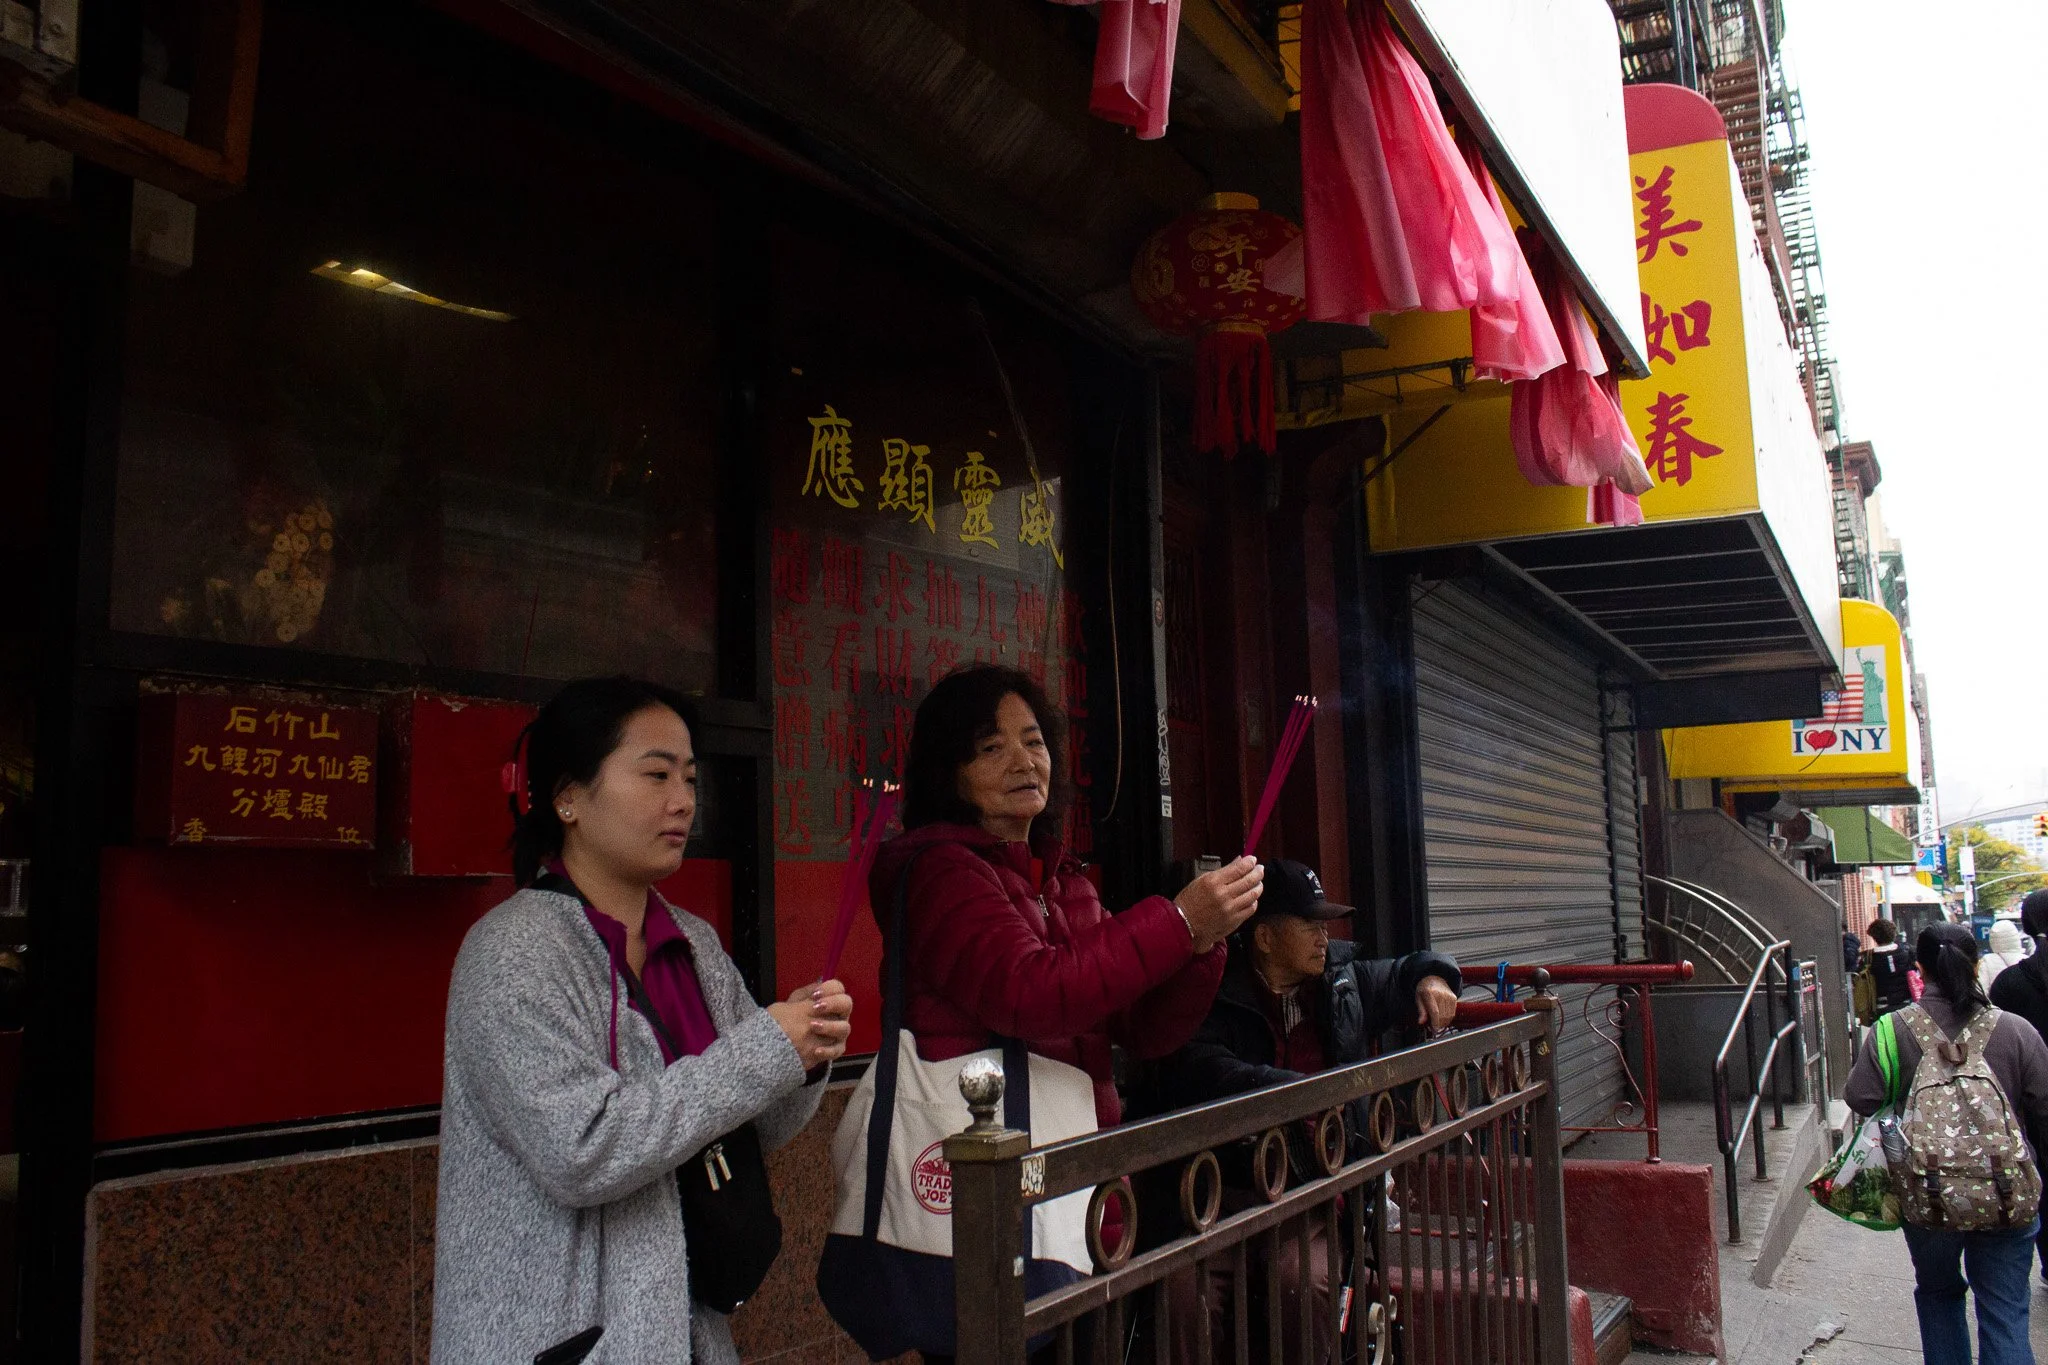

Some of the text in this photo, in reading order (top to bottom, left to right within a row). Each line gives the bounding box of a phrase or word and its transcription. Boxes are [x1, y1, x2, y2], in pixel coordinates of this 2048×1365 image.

[224, 706, 340, 740] 石竹山
[1793, 728, 1887, 753] I NY
[918, 1174, 953, 1190] TRAD
[922, 1189, 953, 1204] JOE'
